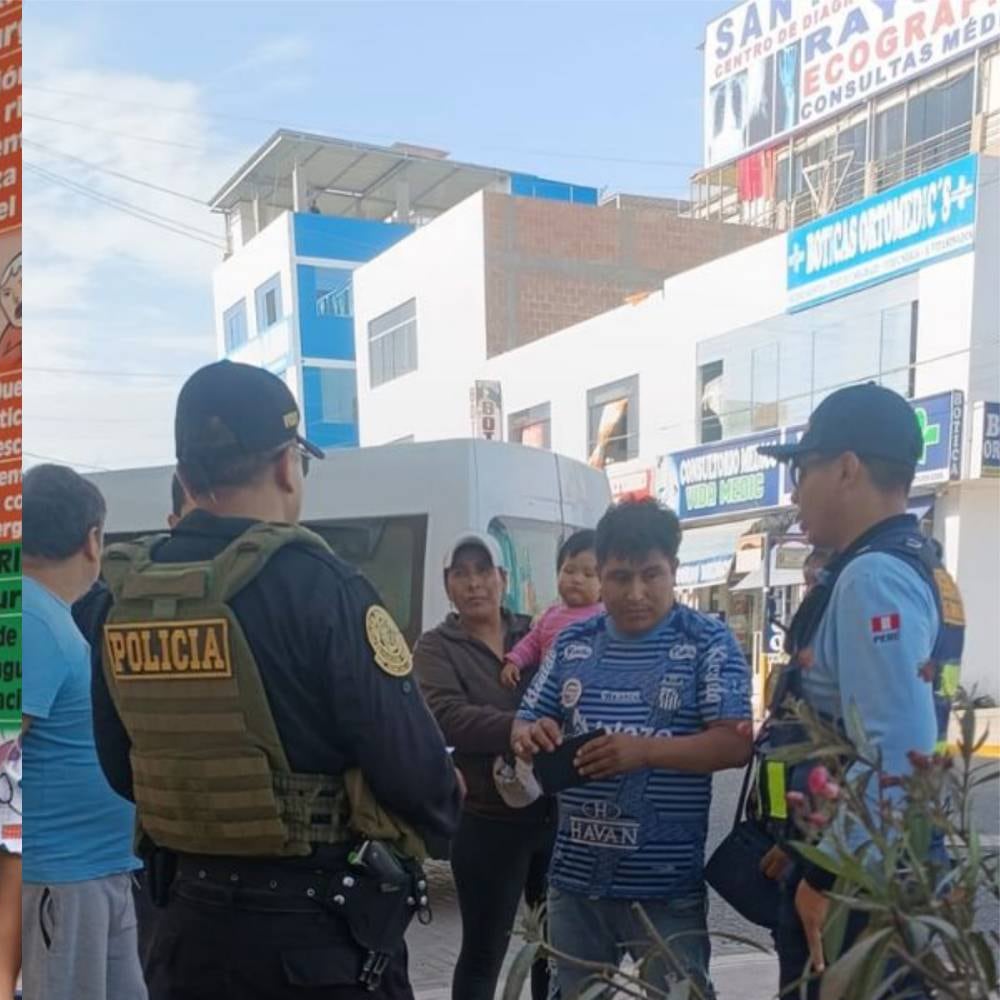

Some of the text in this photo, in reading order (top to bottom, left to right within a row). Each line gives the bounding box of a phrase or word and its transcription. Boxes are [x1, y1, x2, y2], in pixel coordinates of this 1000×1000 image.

[714, 0, 792, 59] SAN
[715, 35, 773, 78] CENTRO
[777, 21, 797, 43] DE
[803, 0, 996, 97] ECOGRAF
[804, 0, 924, 62] RAY
[801, 13, 1000, 119] CONSULTAS MÉD
[109, 627, 226, 674] POLICIA
[570, 821, 639, 845] HAVAN
